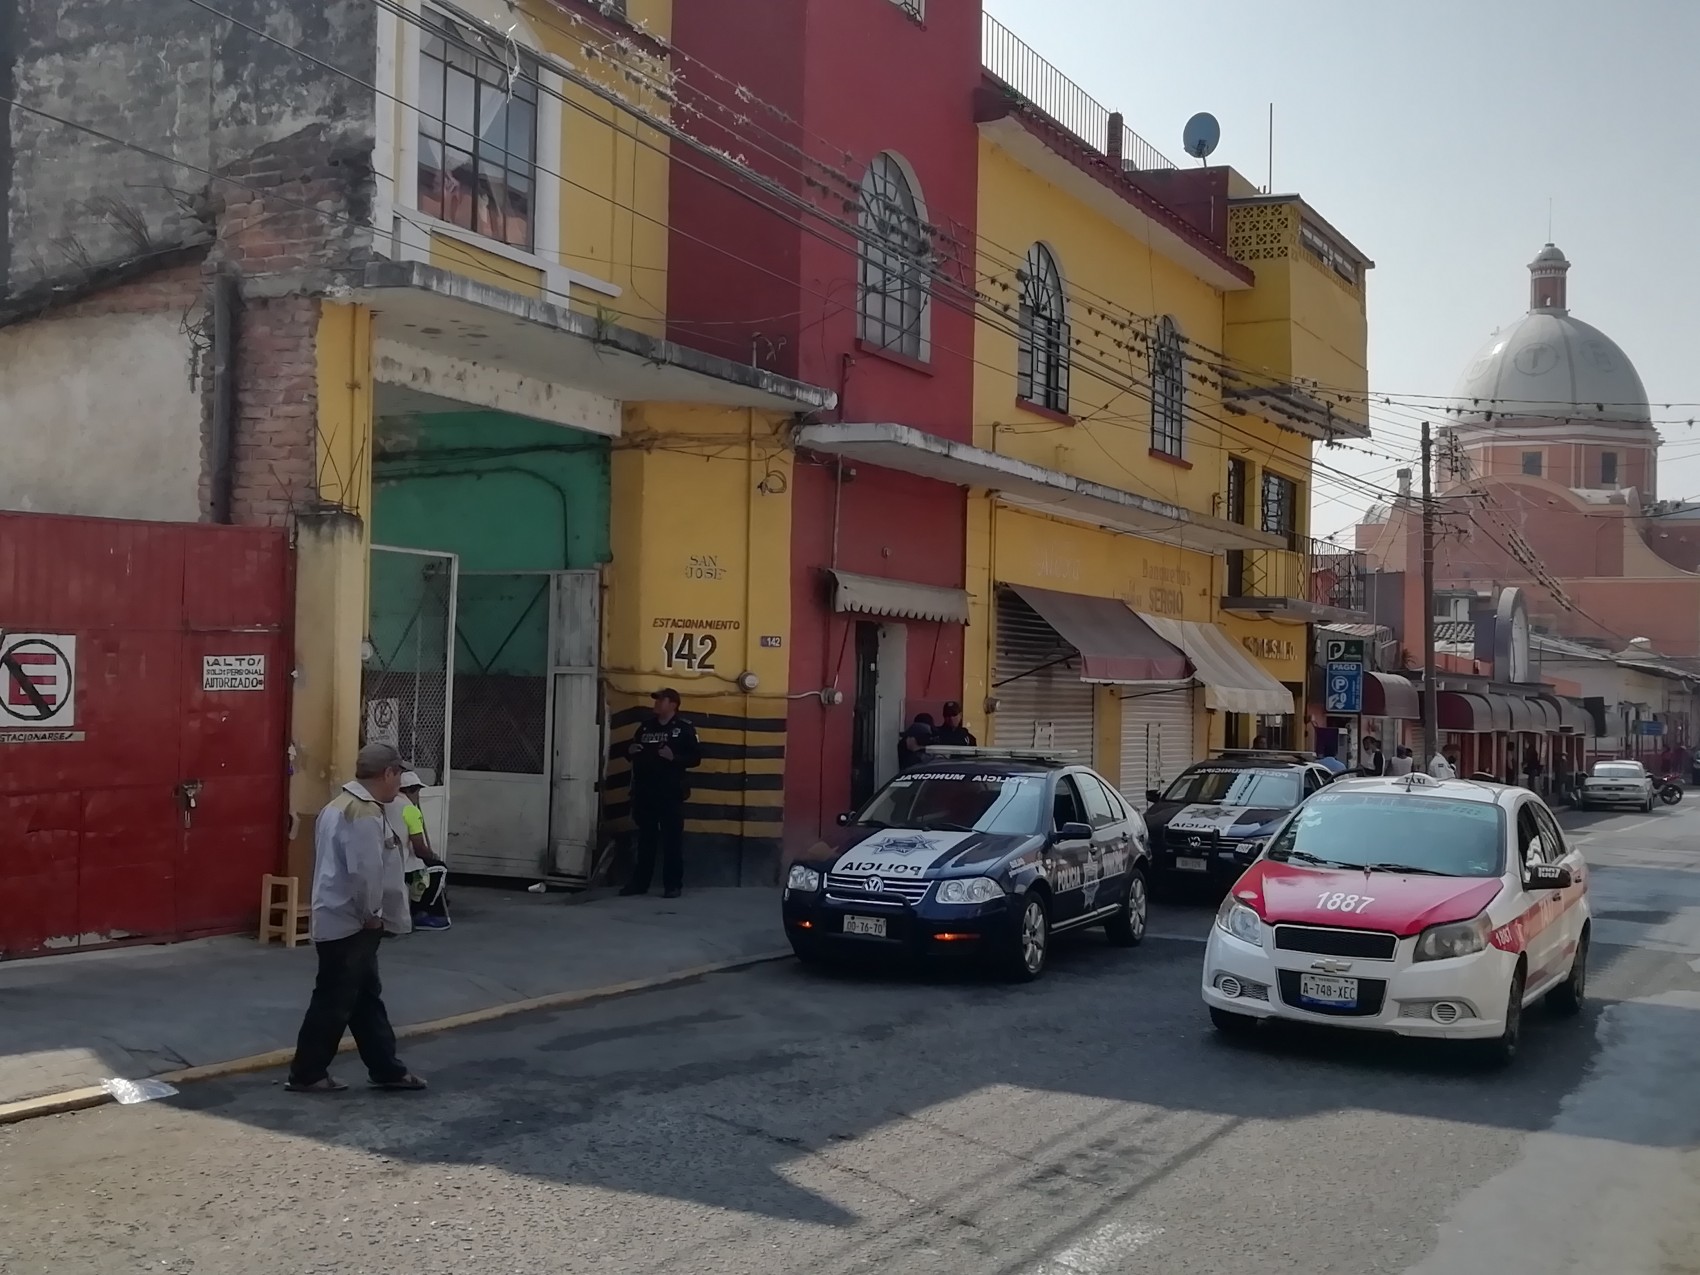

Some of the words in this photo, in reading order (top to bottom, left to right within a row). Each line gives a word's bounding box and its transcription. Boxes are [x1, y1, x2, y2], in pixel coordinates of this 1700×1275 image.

[689, 555, 718, 567] SAN
[1149, 586, 1184, 615] SERGIO
[652, 617, 740, 630] ESTACIONAMIENTO
[767, 637, 780, 647] 142
[662, 632, 717, 671] 142
[226, 668, 264, 676] PERSONAL
[1404, 776, 1426, 785] TAXI
[1316, 891, 1375, 914] 1887
[1495, 926, 1513, 946] 1887
[1302, 982, 1357, 1000] A-748-XEC
